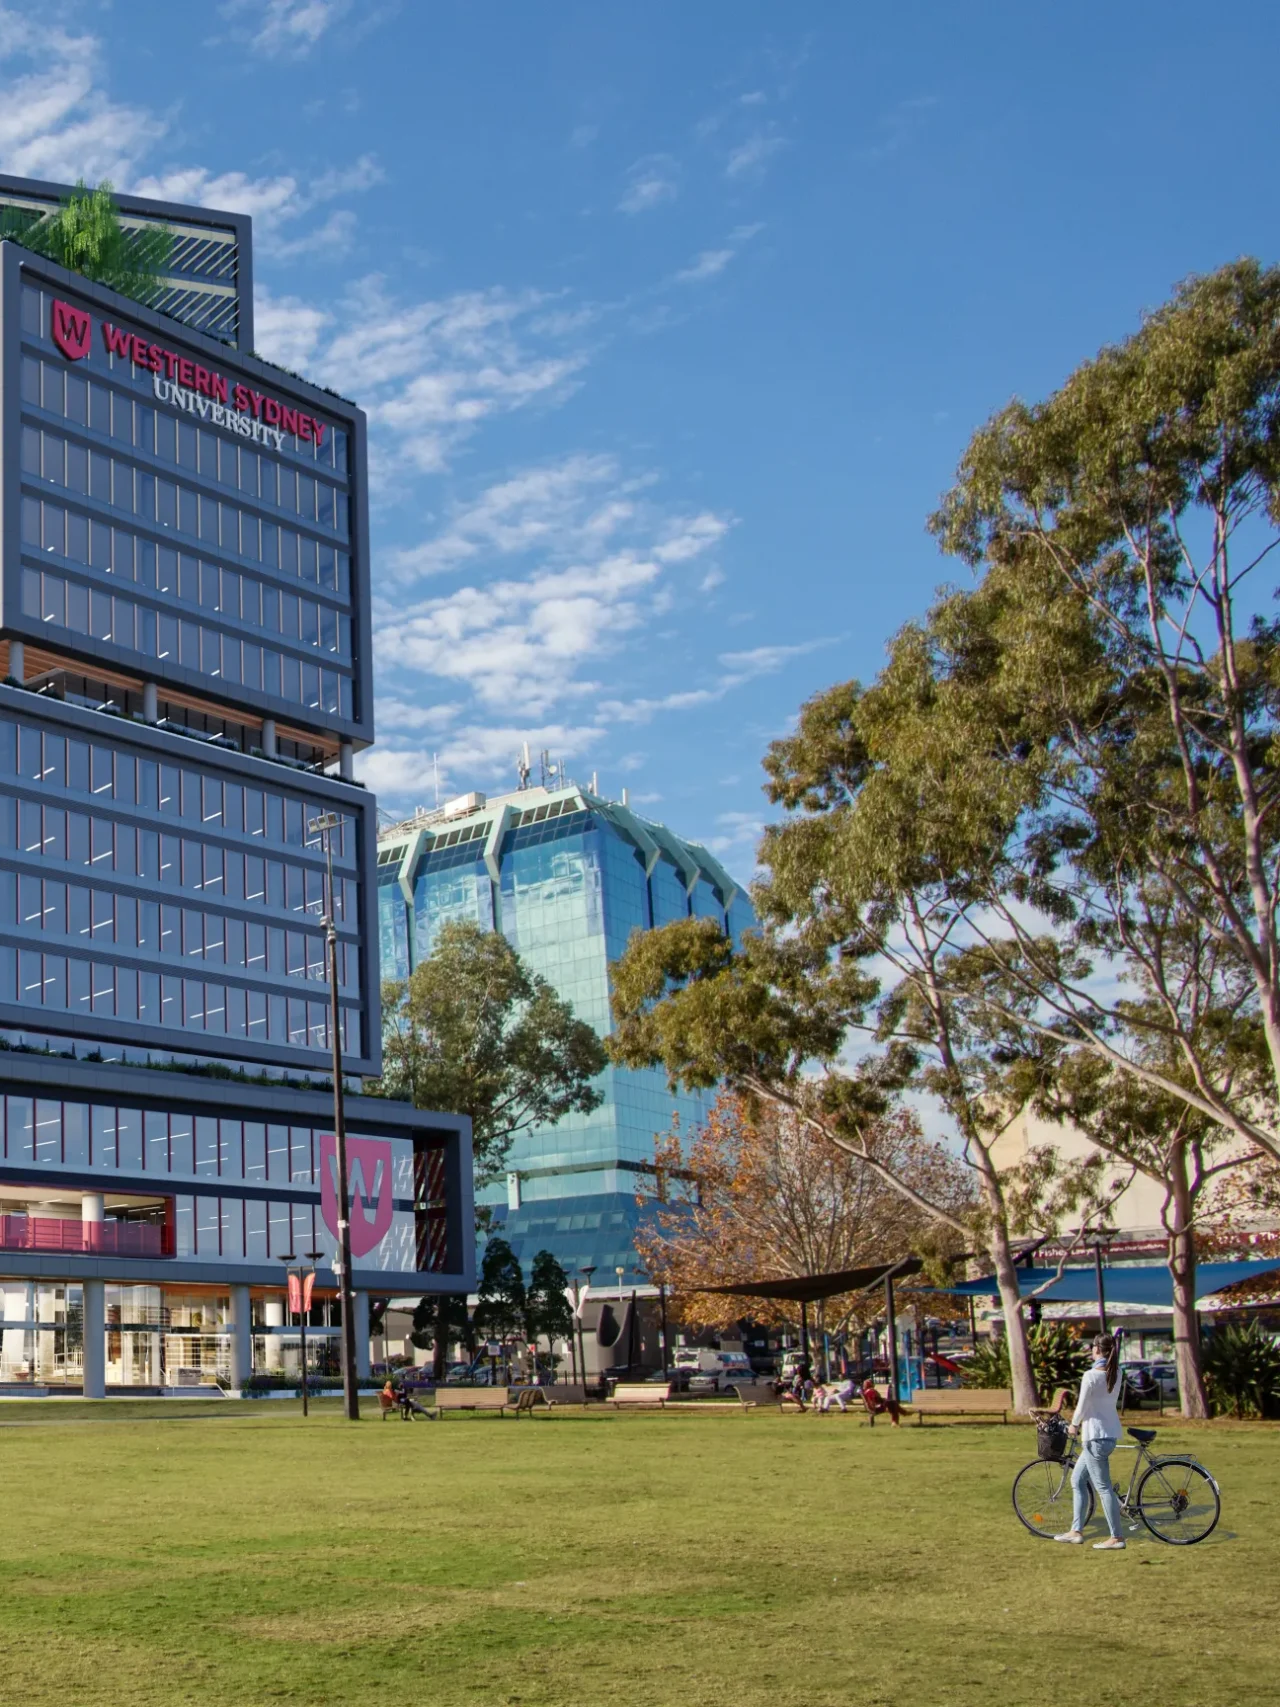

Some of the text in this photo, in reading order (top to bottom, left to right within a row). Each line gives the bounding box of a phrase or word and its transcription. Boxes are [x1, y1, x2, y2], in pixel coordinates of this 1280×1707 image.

[101, 322, 328, 446] WESTERN SYDNEY
[153, 376, 286, 451] UNIVERSITY
[1039, 1248, 1067, 1258] Fishe
